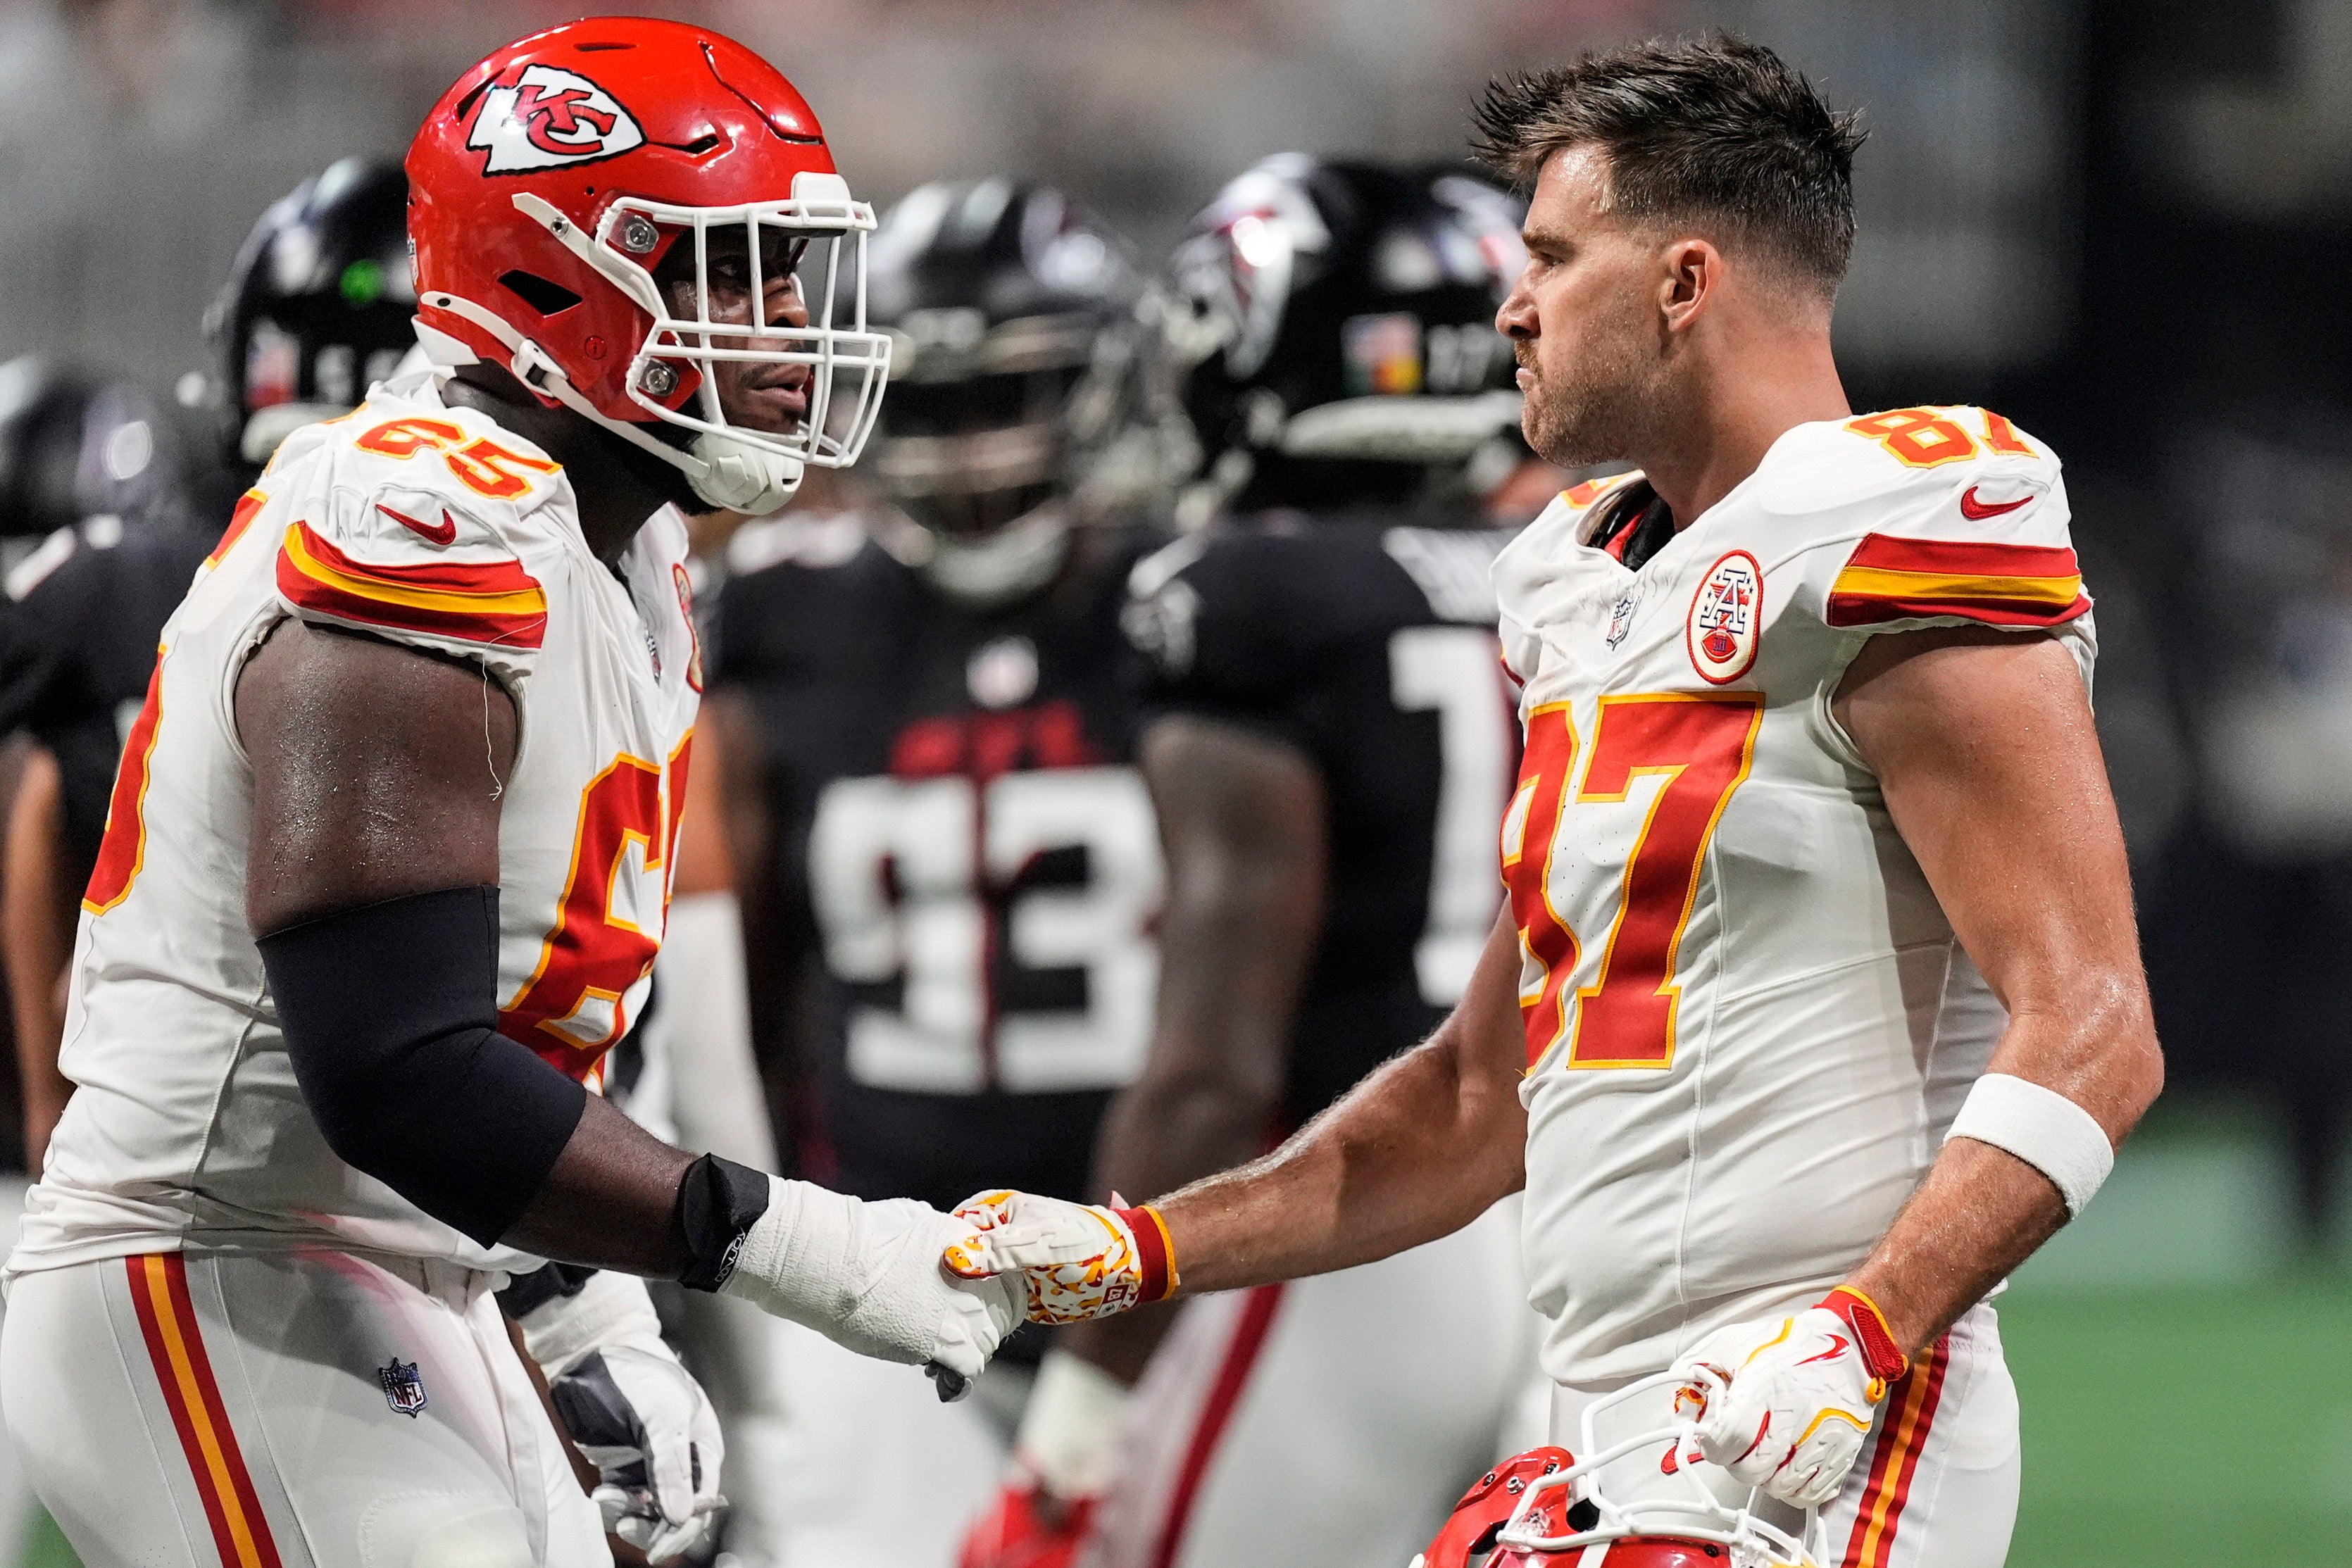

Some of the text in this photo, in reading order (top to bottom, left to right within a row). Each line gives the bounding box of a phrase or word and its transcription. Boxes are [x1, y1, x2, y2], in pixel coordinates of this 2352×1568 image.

[501, 84, 618, 156] KC
[354, 418, 563, 501] 65
[807, 765, 1168, 1095] 93
[1108, 1289, 1122, 1301] 87
[394, 1384, 423, 1406] NFL
